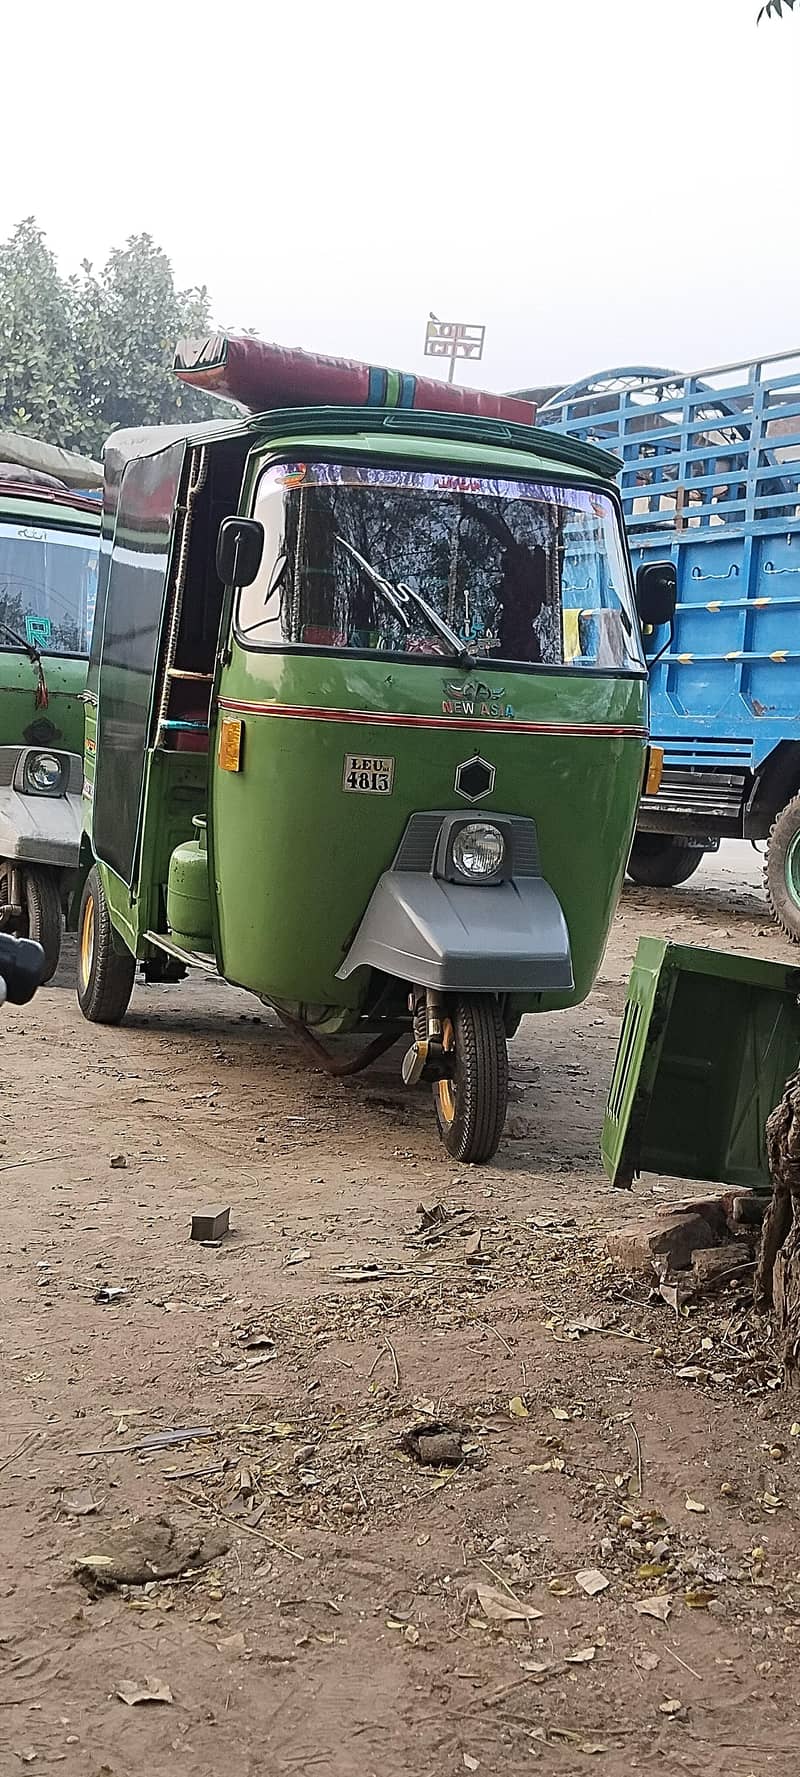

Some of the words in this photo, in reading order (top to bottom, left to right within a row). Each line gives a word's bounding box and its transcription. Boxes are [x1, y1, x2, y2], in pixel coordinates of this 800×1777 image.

[430, 341, 474, 357] CITY
[25, 615, 50, 649] R
[442, 700, 474, 716] NEW
[480, 702, 515, 719] ASIA
[351, 759, 383, 771] LEU
[347, 771, 389, 791] 4813
